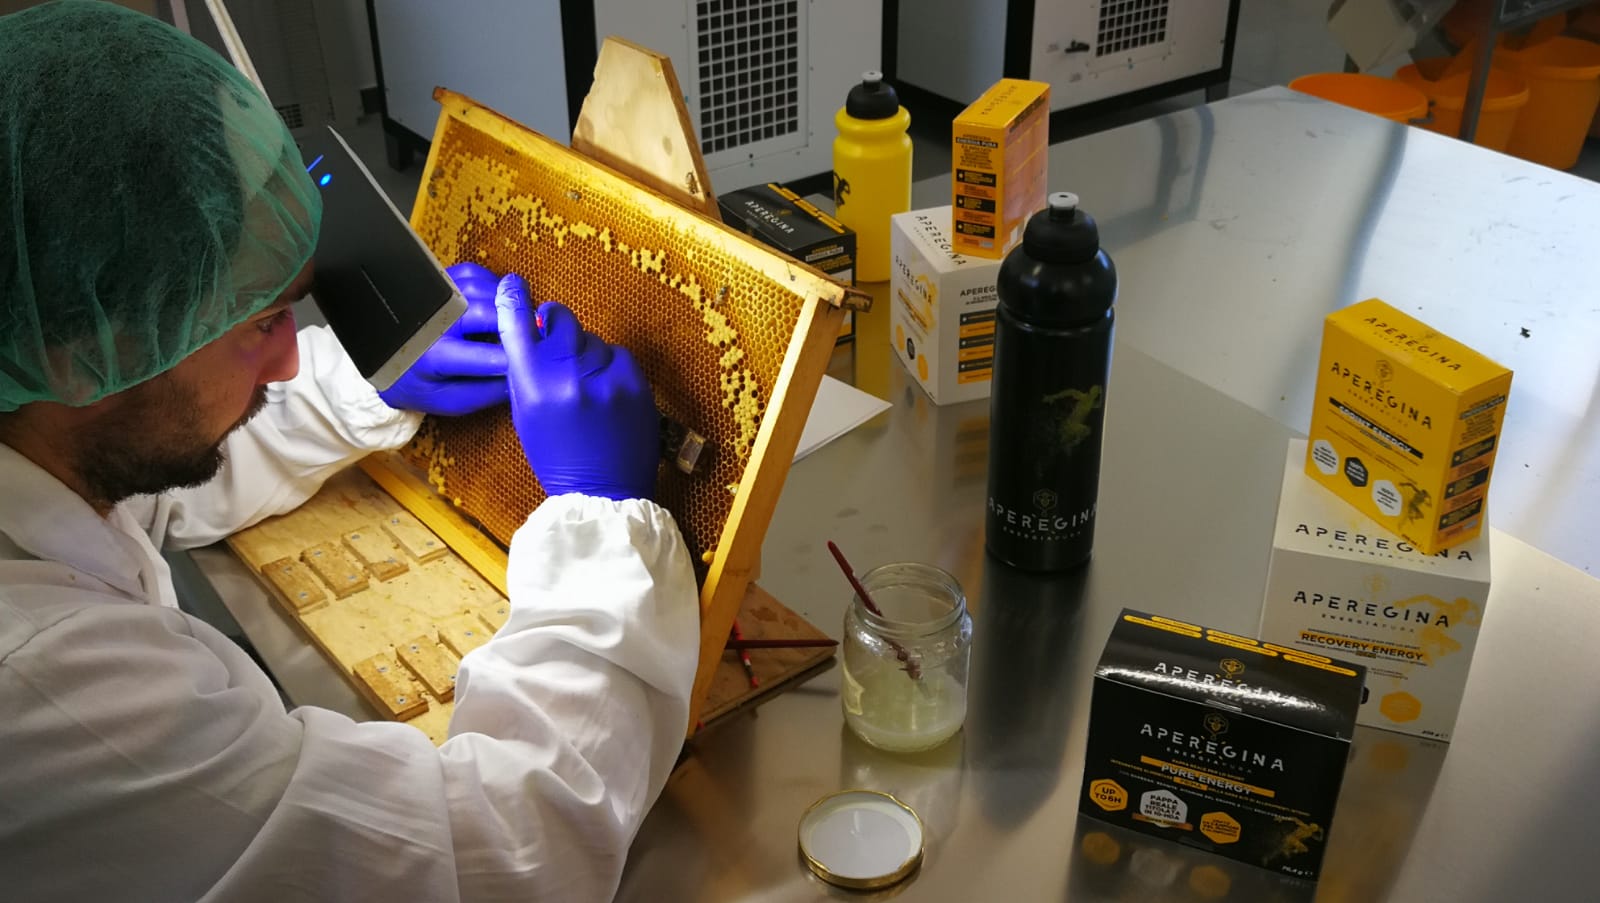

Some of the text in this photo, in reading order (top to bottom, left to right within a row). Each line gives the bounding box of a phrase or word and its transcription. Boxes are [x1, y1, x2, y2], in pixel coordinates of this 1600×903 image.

[1364, 317, 1463, 372] APEREGINA
[1331, 361, 1432, 430] APEREGINA
[1295, 523, 1473, 562] APEREGNA
[1293, 590, 1449, 628] APEREGINA
[1300, 632, 1370, 651] RECOVERY
[1371, 645, 1424, 661] ENERGY
[1140, 723, 1284, 772] APEREGINA
[1102, 787, 1116, 796] UP
[1161, 763, 1196, 781] PURE
[1197, 775, 1252, 796] ENERGY
[1150, 794, 1178, 805] PAPPA
[1150, 800, 1177, 811] REALE
